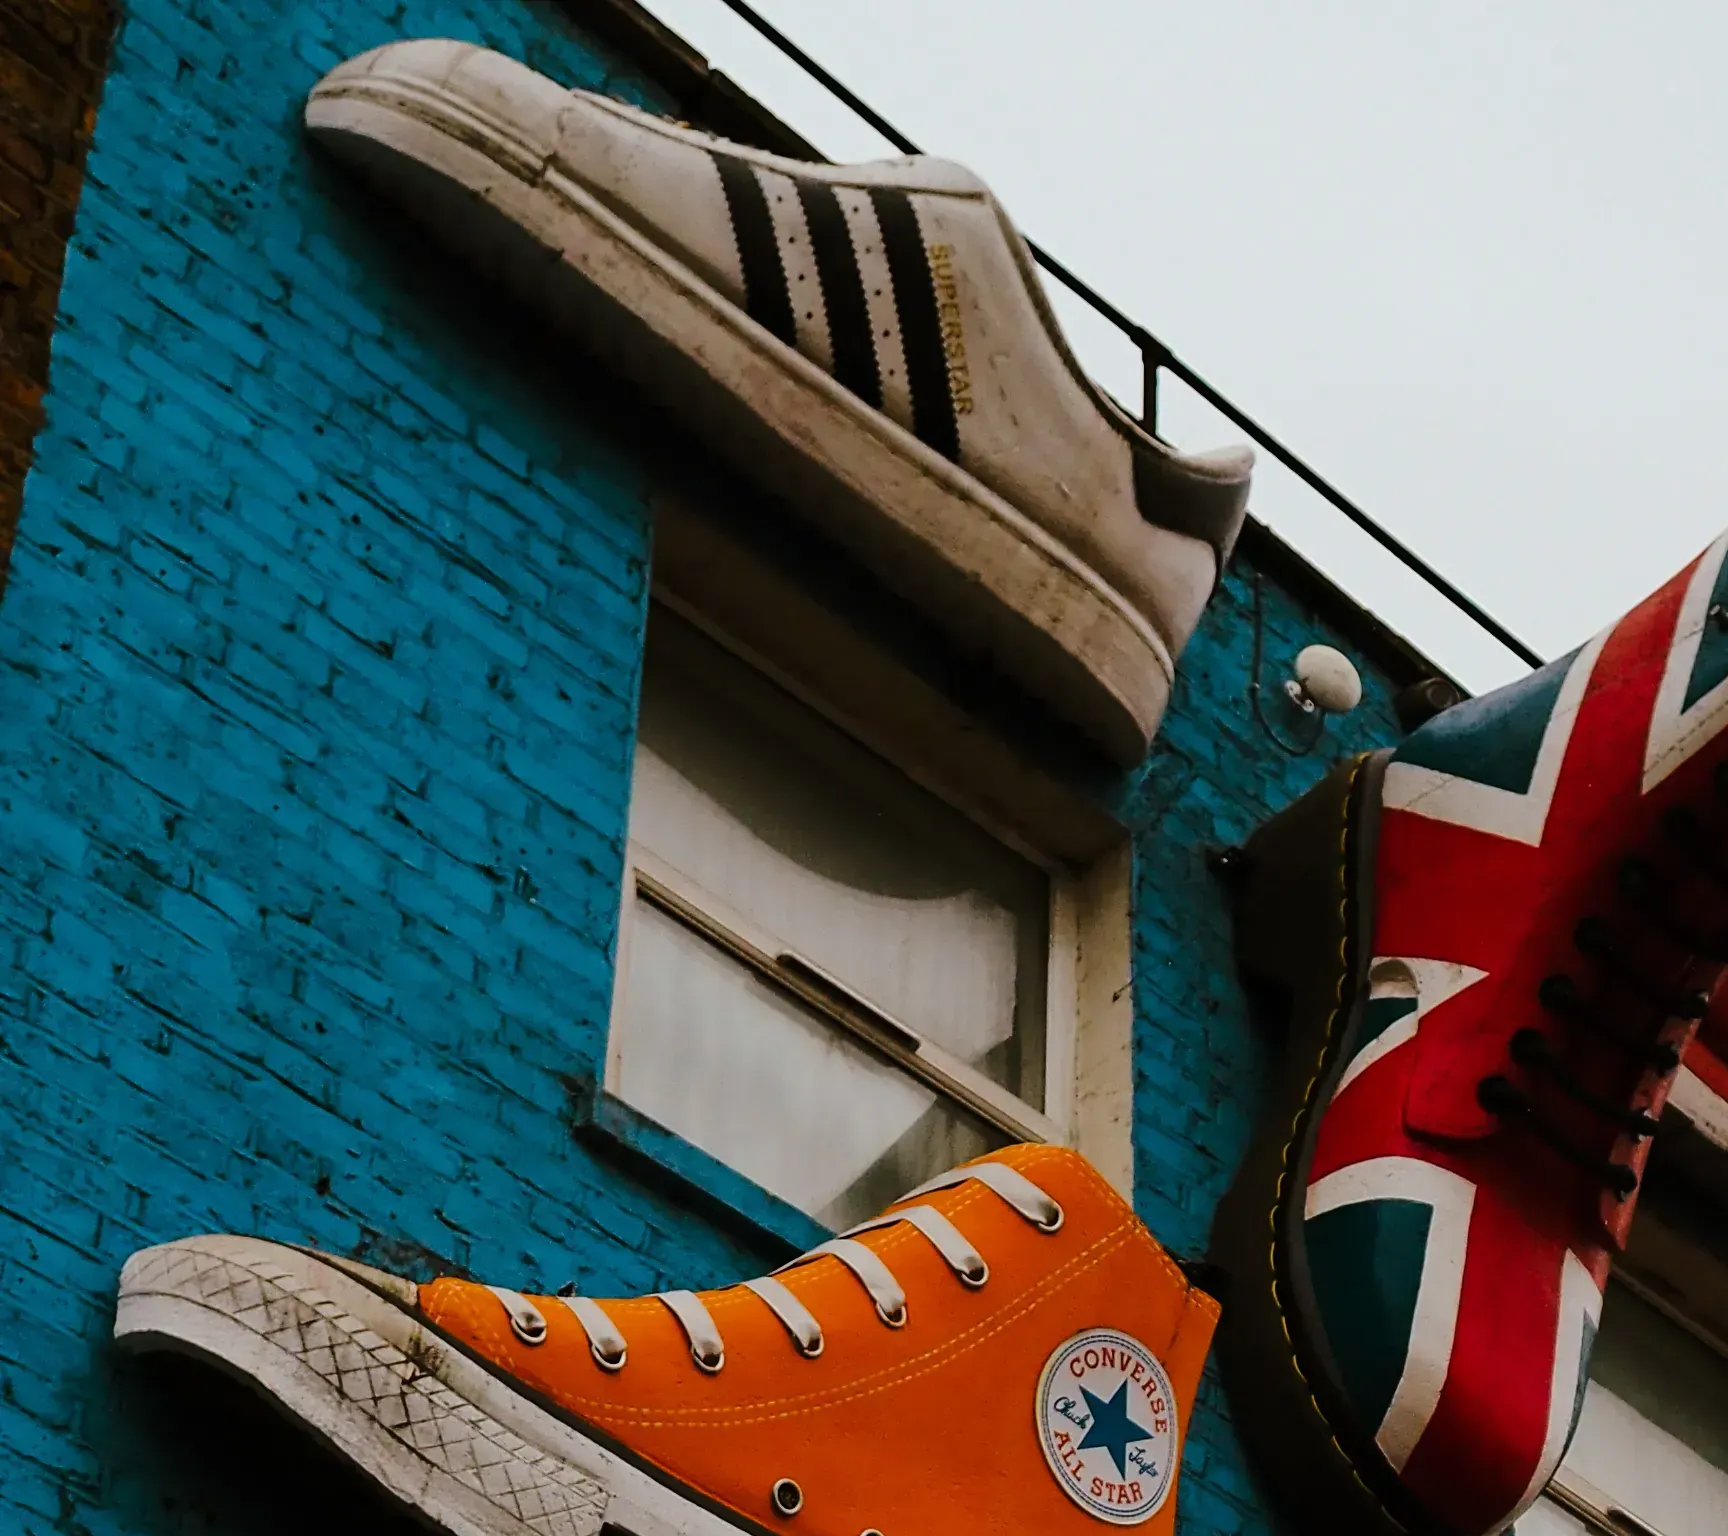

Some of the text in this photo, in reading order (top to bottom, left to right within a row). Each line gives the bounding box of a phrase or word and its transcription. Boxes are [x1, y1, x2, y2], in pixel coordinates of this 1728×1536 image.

[930, 244, 973, 416] SUPERSTAR
[1053, 1396, 1091, 1430] Chuck
[1070, 1347, 1167, 1433] CONVERSE
[1054, 1430, 1143, 1504] ALL STAR
